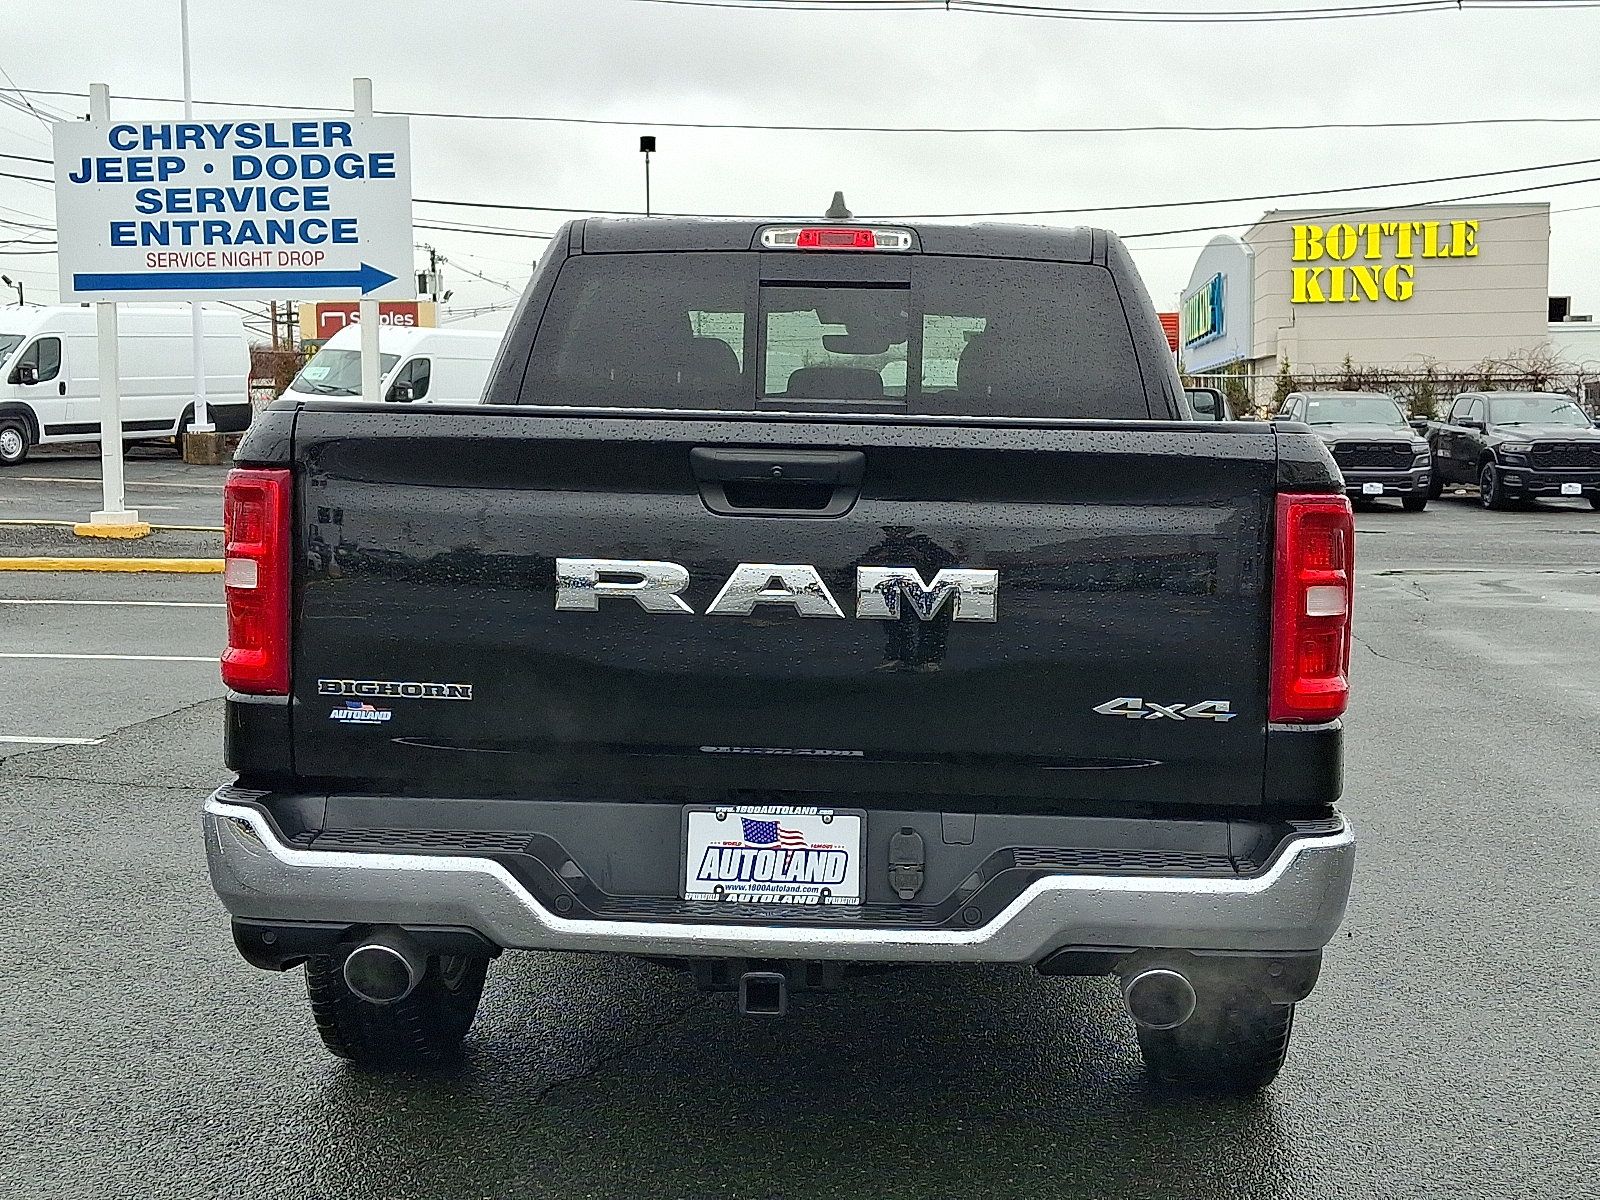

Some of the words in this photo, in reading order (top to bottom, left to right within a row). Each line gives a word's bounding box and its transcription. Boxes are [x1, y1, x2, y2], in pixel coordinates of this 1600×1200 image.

[108, 121, 352, 150] CHRYSLER
[69, 156, 186, 184] JEEP
[232, 153, 396, 181] DODGE
[135, 185, 330, 214] SERVICE
[110, 218, 359, 247] ENTRANCE
[1291, 219, 1480, 261] BOTTLE
[146, 252, 217, 268] SERVICE
[222, 252, 272, 267] NIGHT
[278, 251, 325, 266] DROP
[1291, 264, 1415, 304] KING
[350, 311, 415, 326] Sples
[555, 557, 999, 623] RAM
[318, 679, 473, 700] BIGHORN
[329, 709, 392, 721] AUTOLAND
[696, 846, 849, 884] AUTOLAND
[725, 884, 819, 894] www.1800Autoland.com
[725, 893, 819, 905] AUTOLAND
